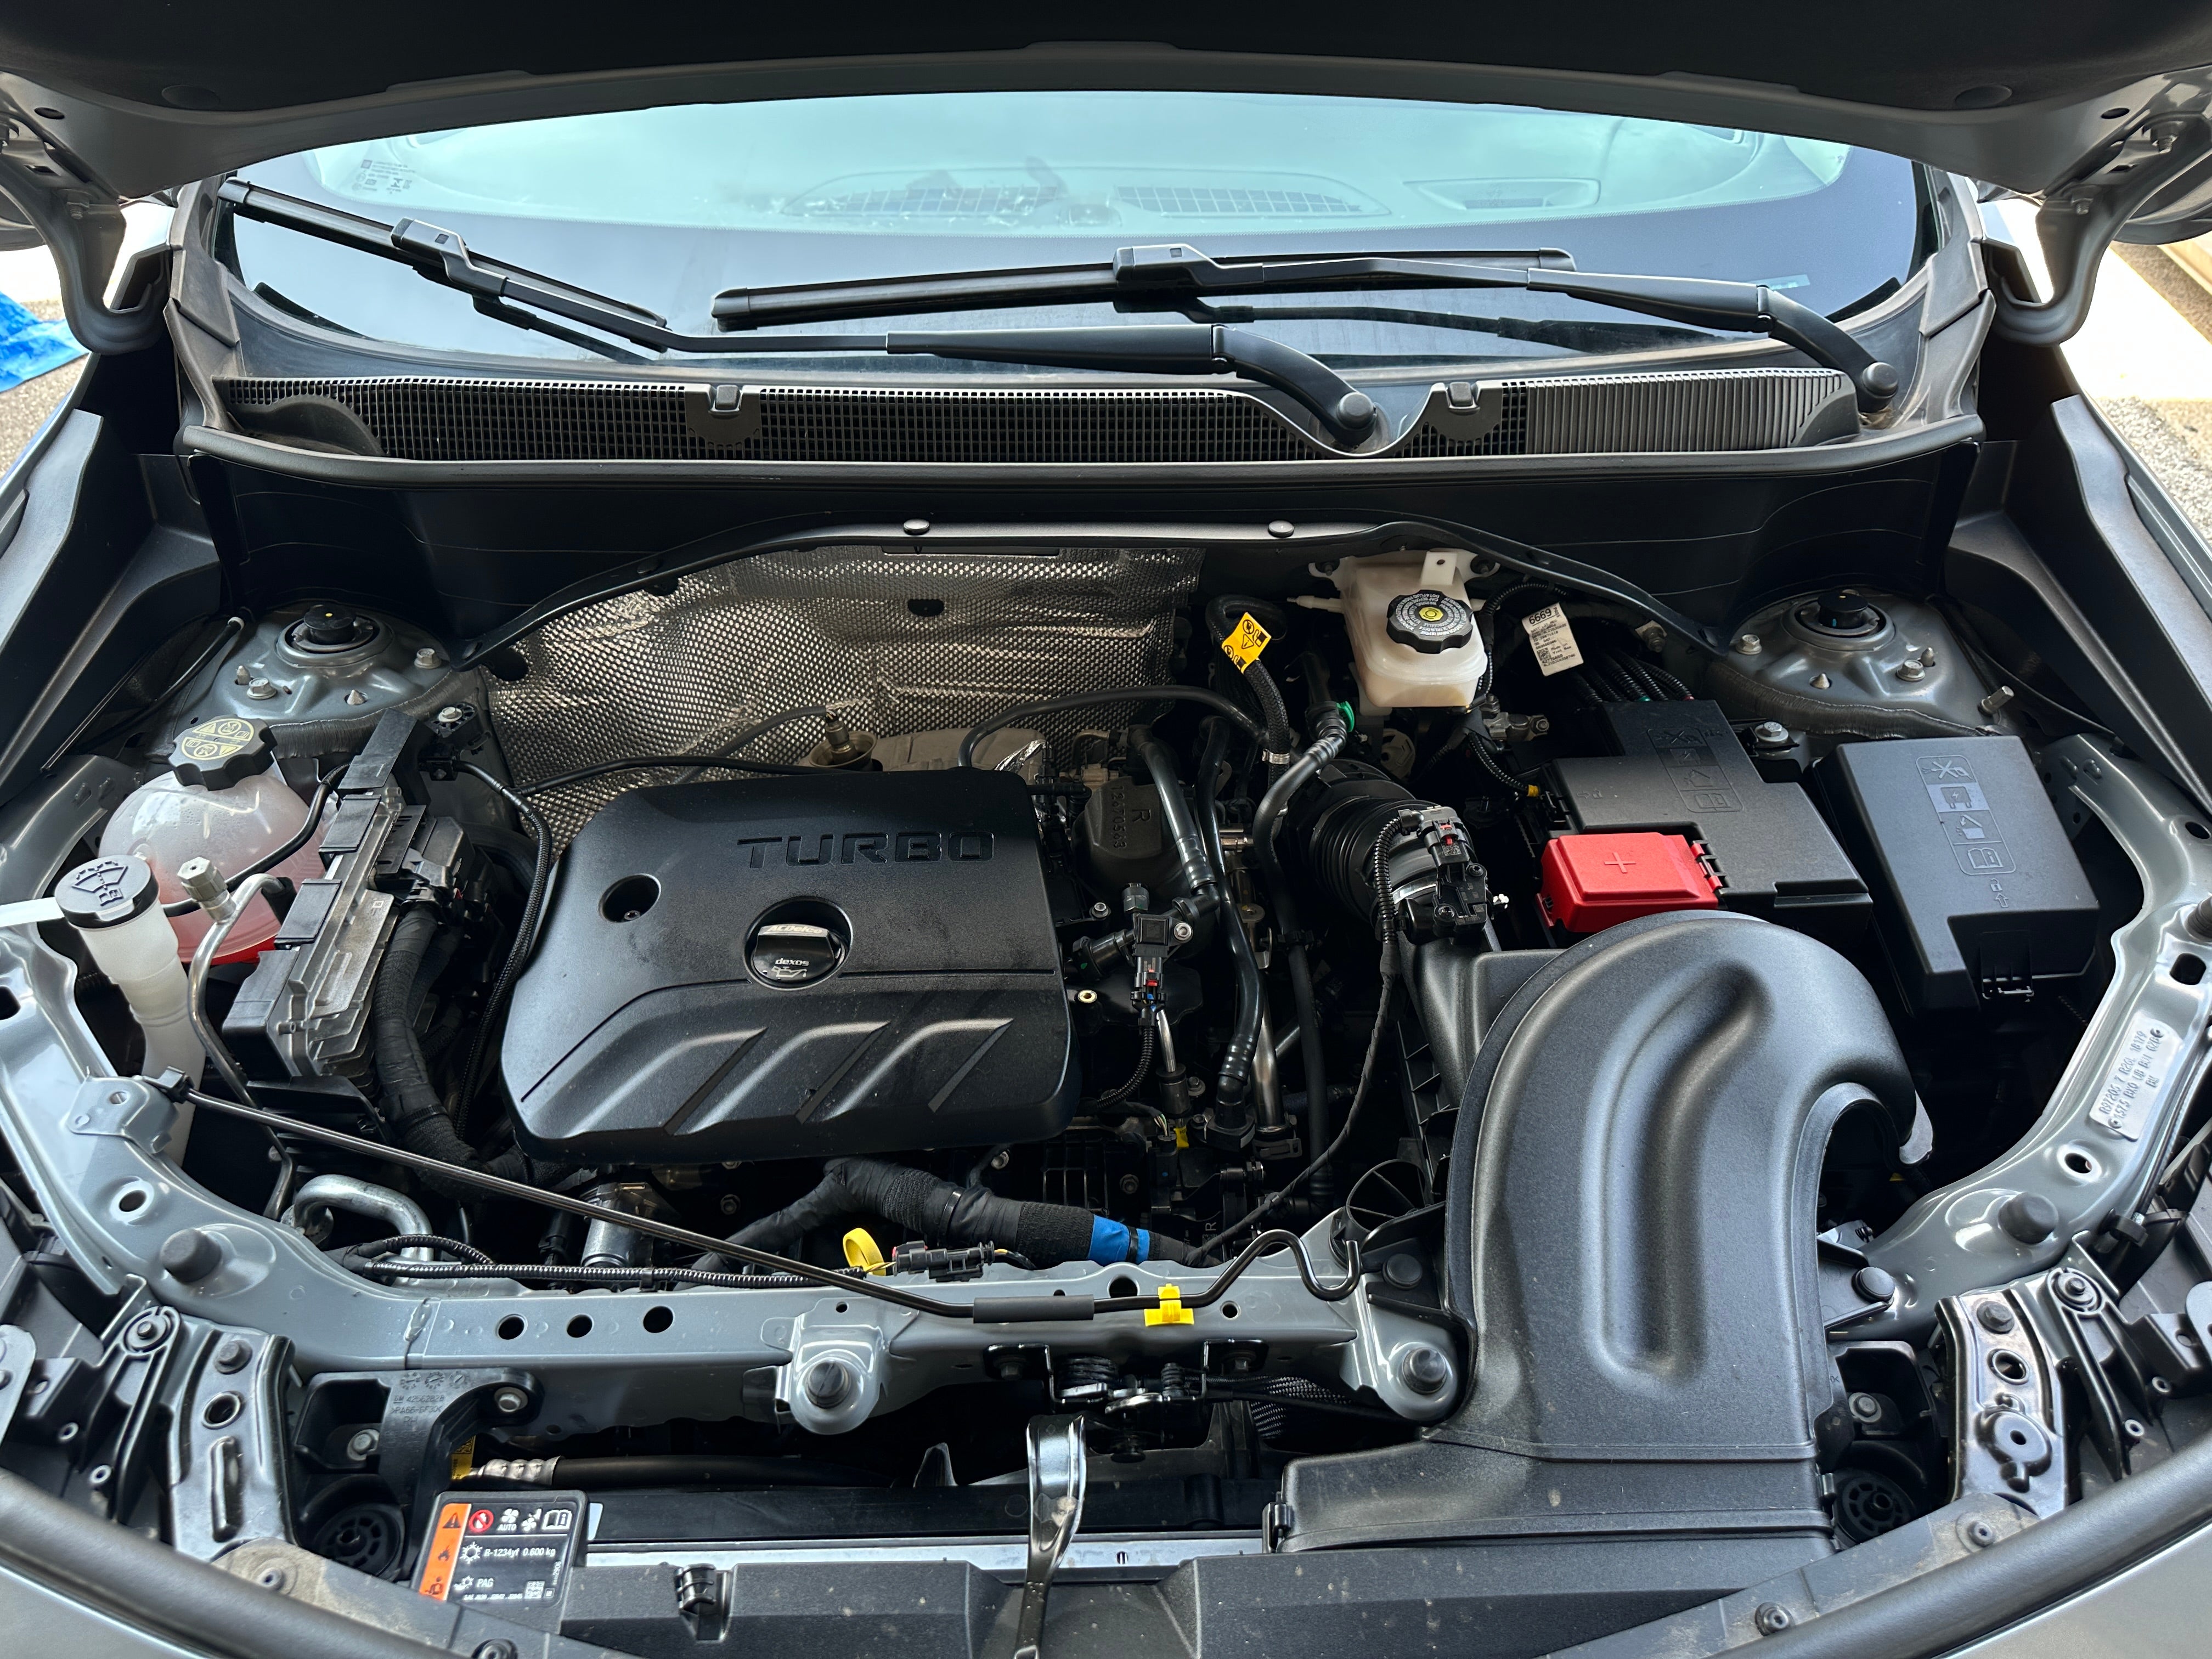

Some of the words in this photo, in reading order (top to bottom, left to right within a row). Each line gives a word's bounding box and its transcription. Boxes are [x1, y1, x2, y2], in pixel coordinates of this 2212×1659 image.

[1529, 608, 1551, 624] 6669
[1132, 809, 1152, 822] R
[737, 831, 995, 868] TURBO
[766, 924, 823, 934] ACDelco
[775, 957, 810, 967] dexos
[484, 1548, 519, 1558] R-1234yf
[523, 1548, 544, 1556] 0.600
[545, 1547, 556, 1557] kg
[477, 1578, 494, 1587] PAG
